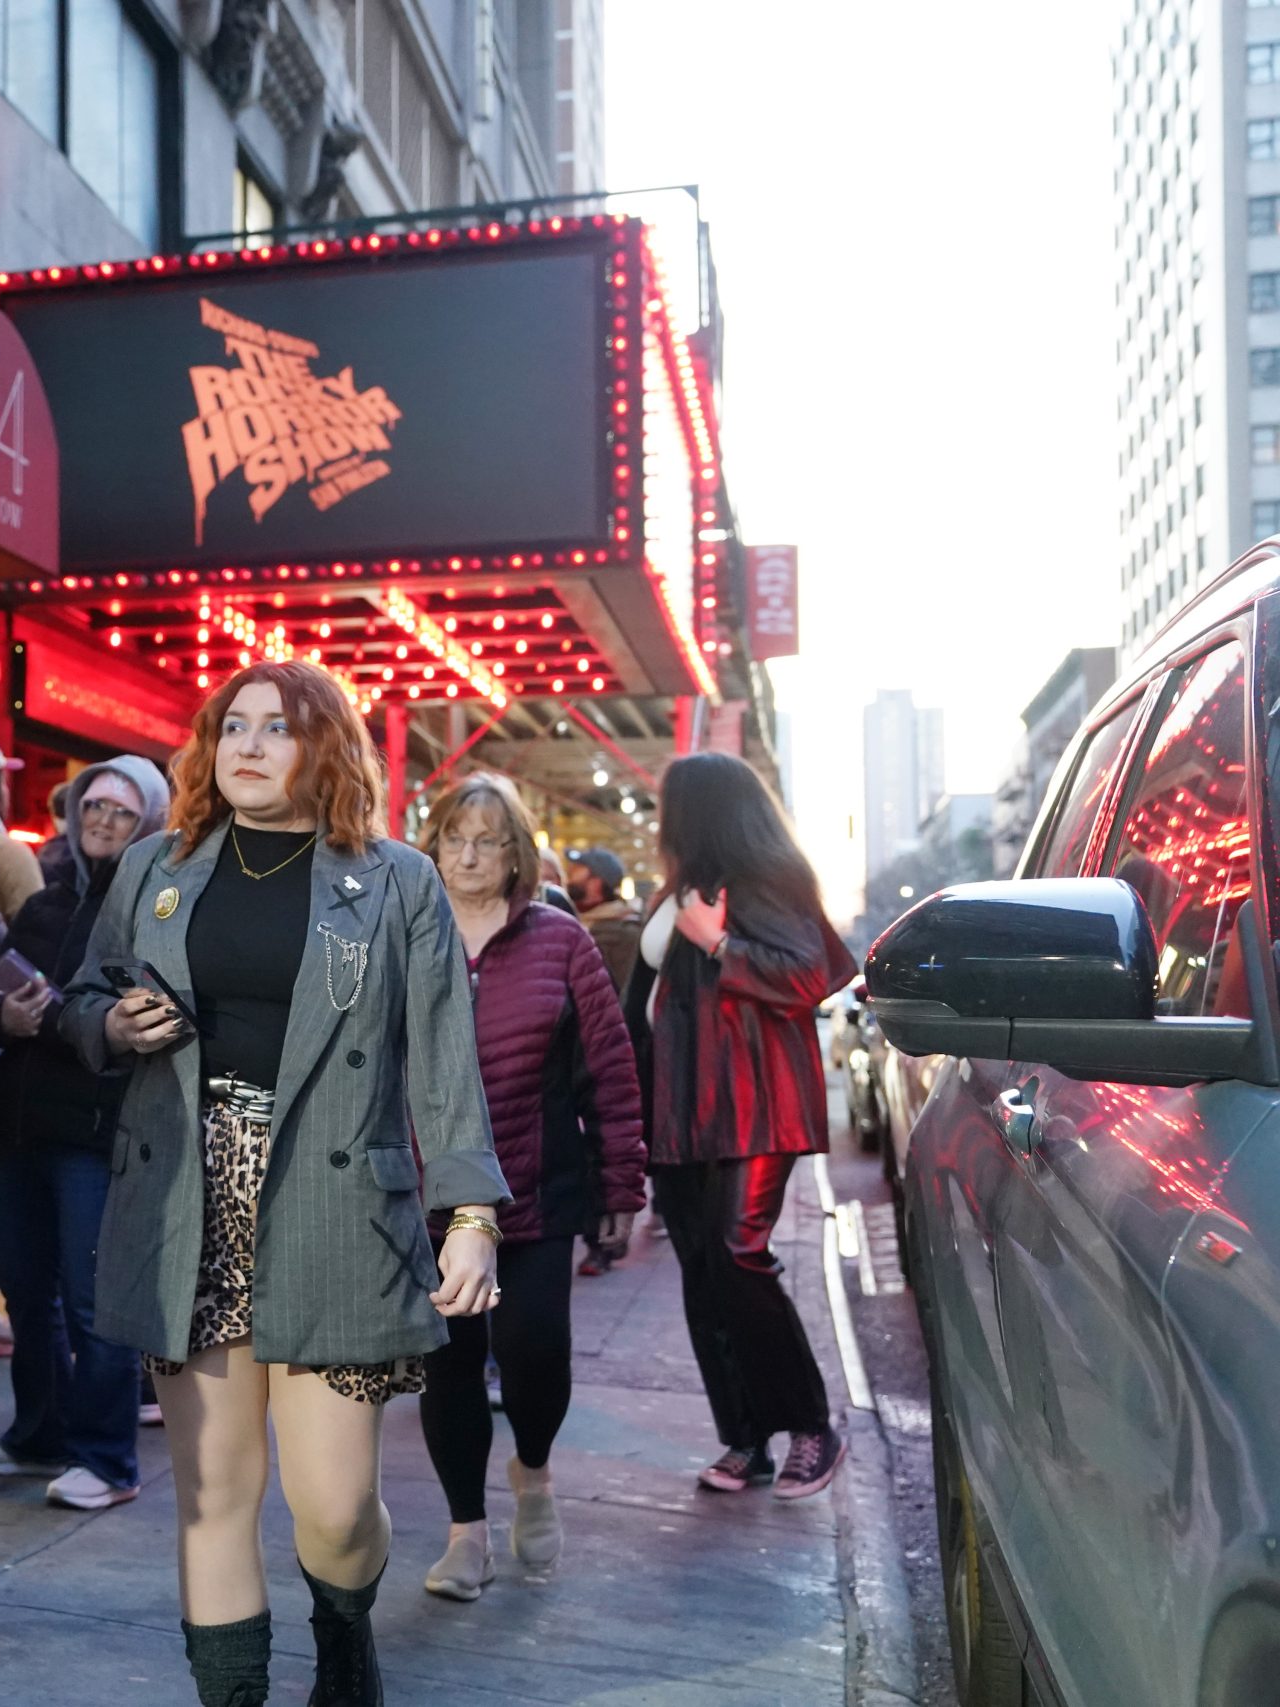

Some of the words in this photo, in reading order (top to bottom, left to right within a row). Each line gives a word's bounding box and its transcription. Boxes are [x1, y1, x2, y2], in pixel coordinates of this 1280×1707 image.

[188, 365, 358, 417] ROCKY
[224, 335, 312, 380] THE
[181, 386, 403, 546] HORROR
[244, 424, 392, 524] SHOW
